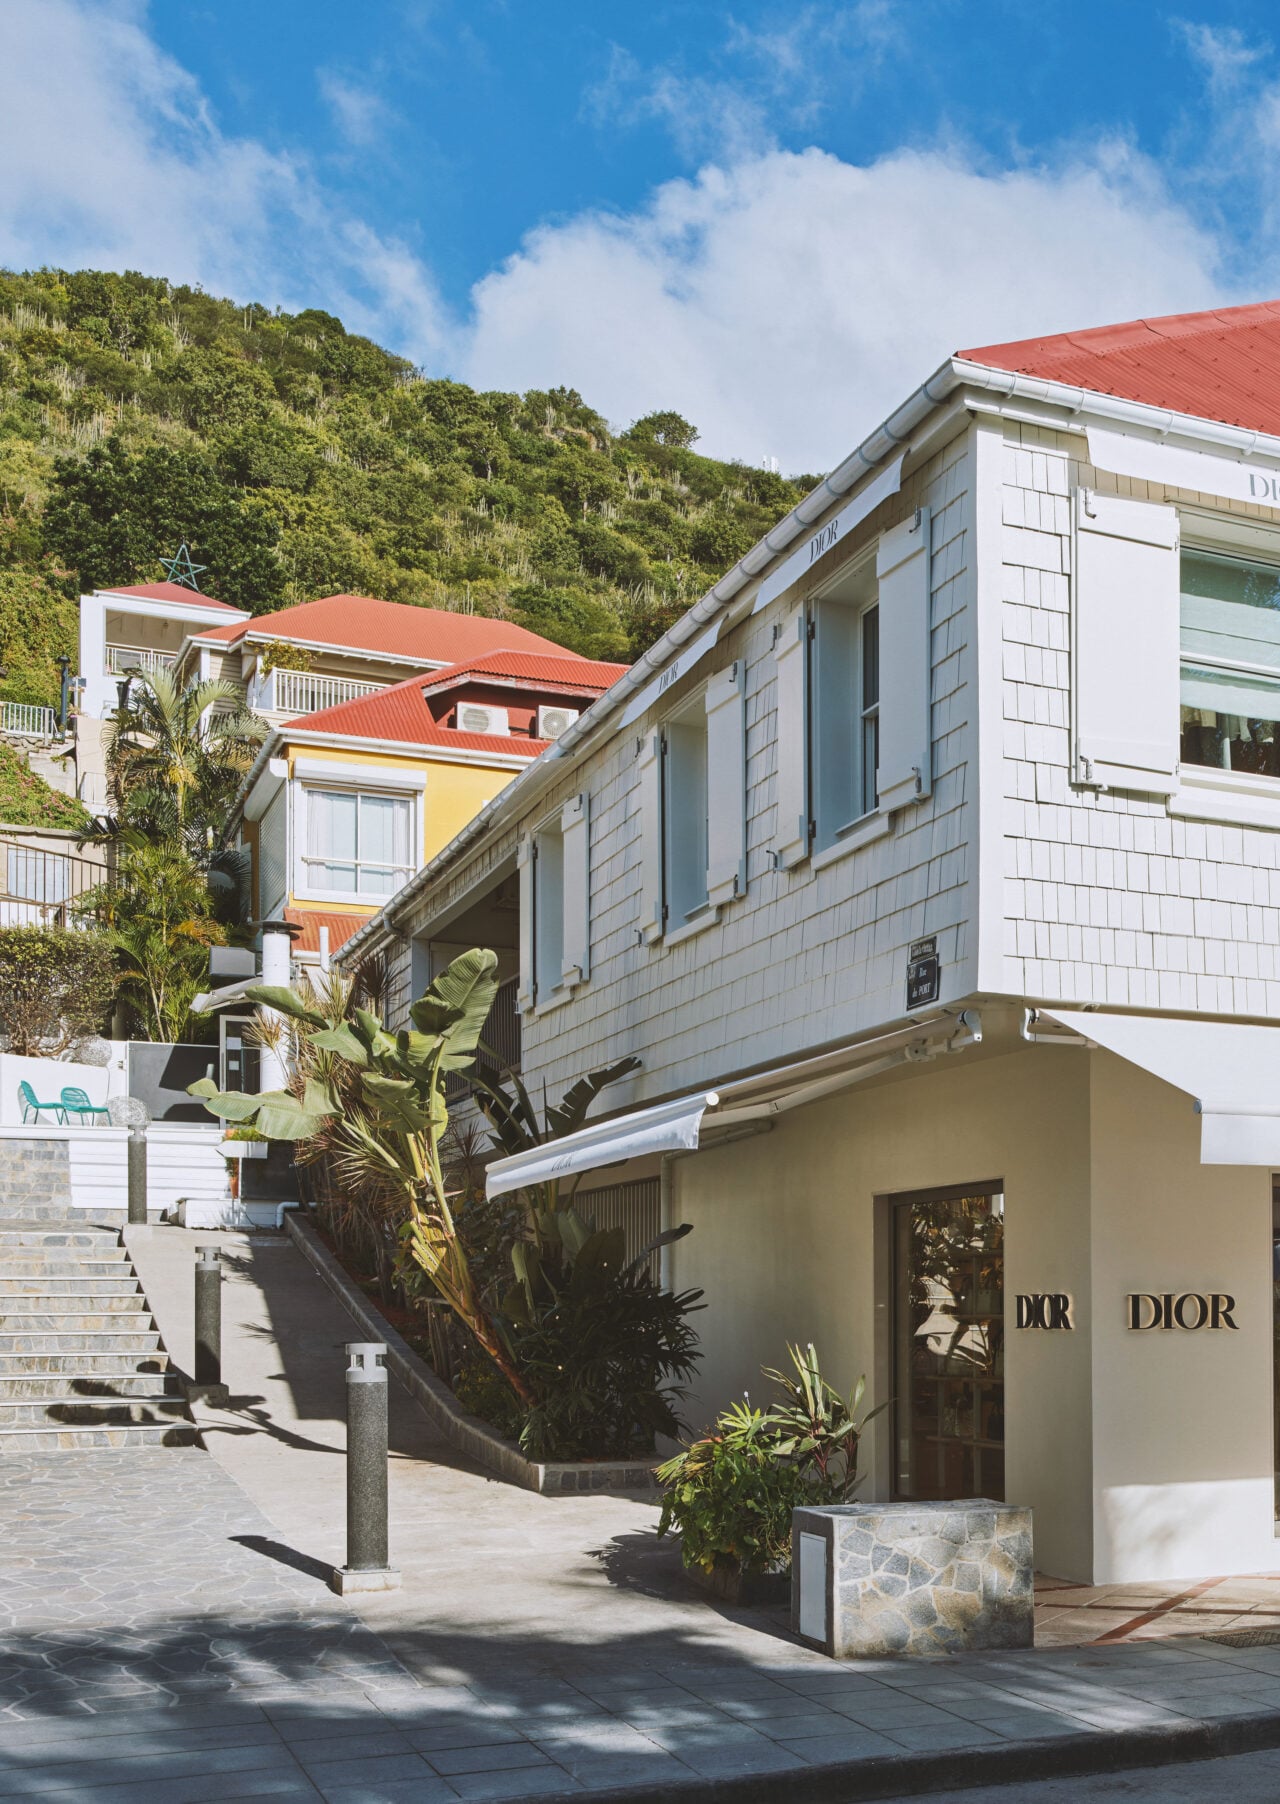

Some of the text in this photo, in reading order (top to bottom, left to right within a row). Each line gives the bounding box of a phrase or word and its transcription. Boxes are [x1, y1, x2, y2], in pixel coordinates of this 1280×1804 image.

[809, 519, 838, 563] DIOR
[1015, 1293, 1072, 1330] DIOR
[1127, 1293, 1240, 1330] DIOR
